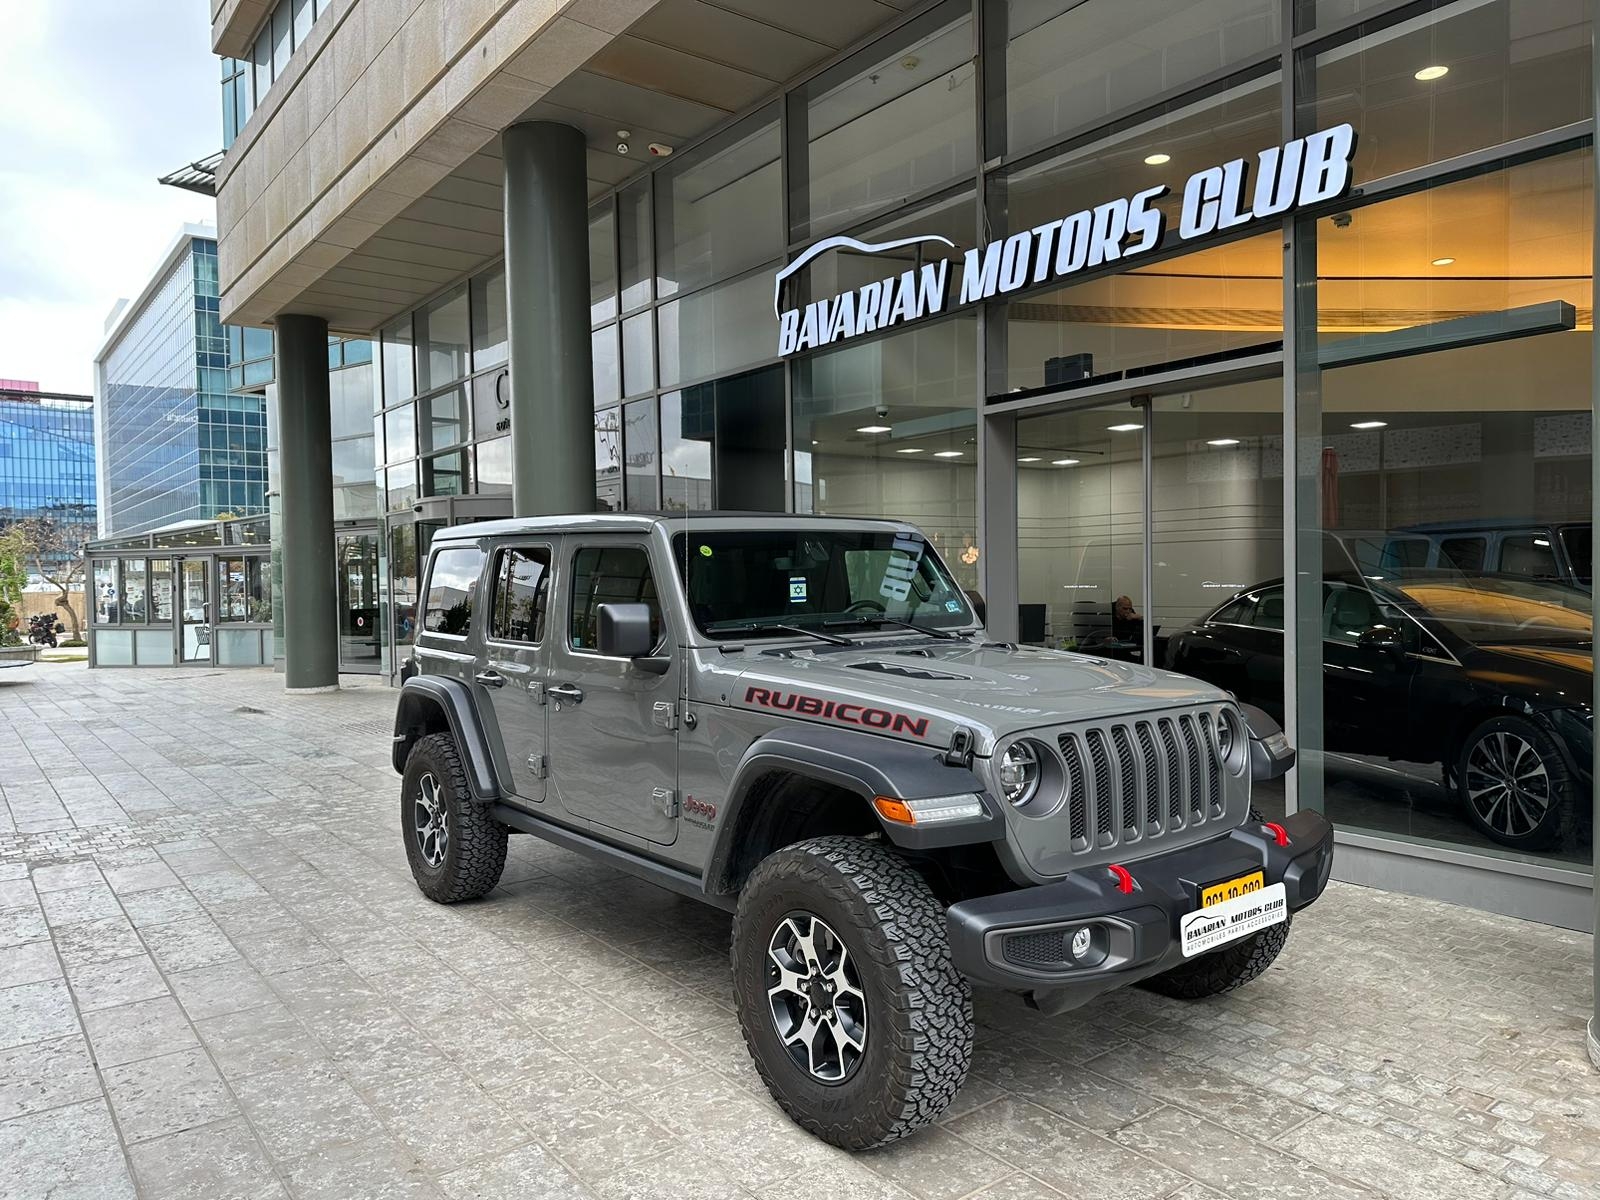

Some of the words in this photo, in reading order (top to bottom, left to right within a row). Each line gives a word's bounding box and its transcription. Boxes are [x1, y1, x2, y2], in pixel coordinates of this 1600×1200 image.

[777, 257, 950, 358] BAVARIAN
[959, 184, 1167, 305] MOTORS
[1179, 122, 1355, 240] CLUB
[745, 686, 930, 738] RUBICON
[683, 793, 717, 822] Jeep
[1187, 919, 1227, 941] BAVARIAN
[1231, 905, 1263, 924] MOTORS
[1264, 898, 1284, 912] CLUB
